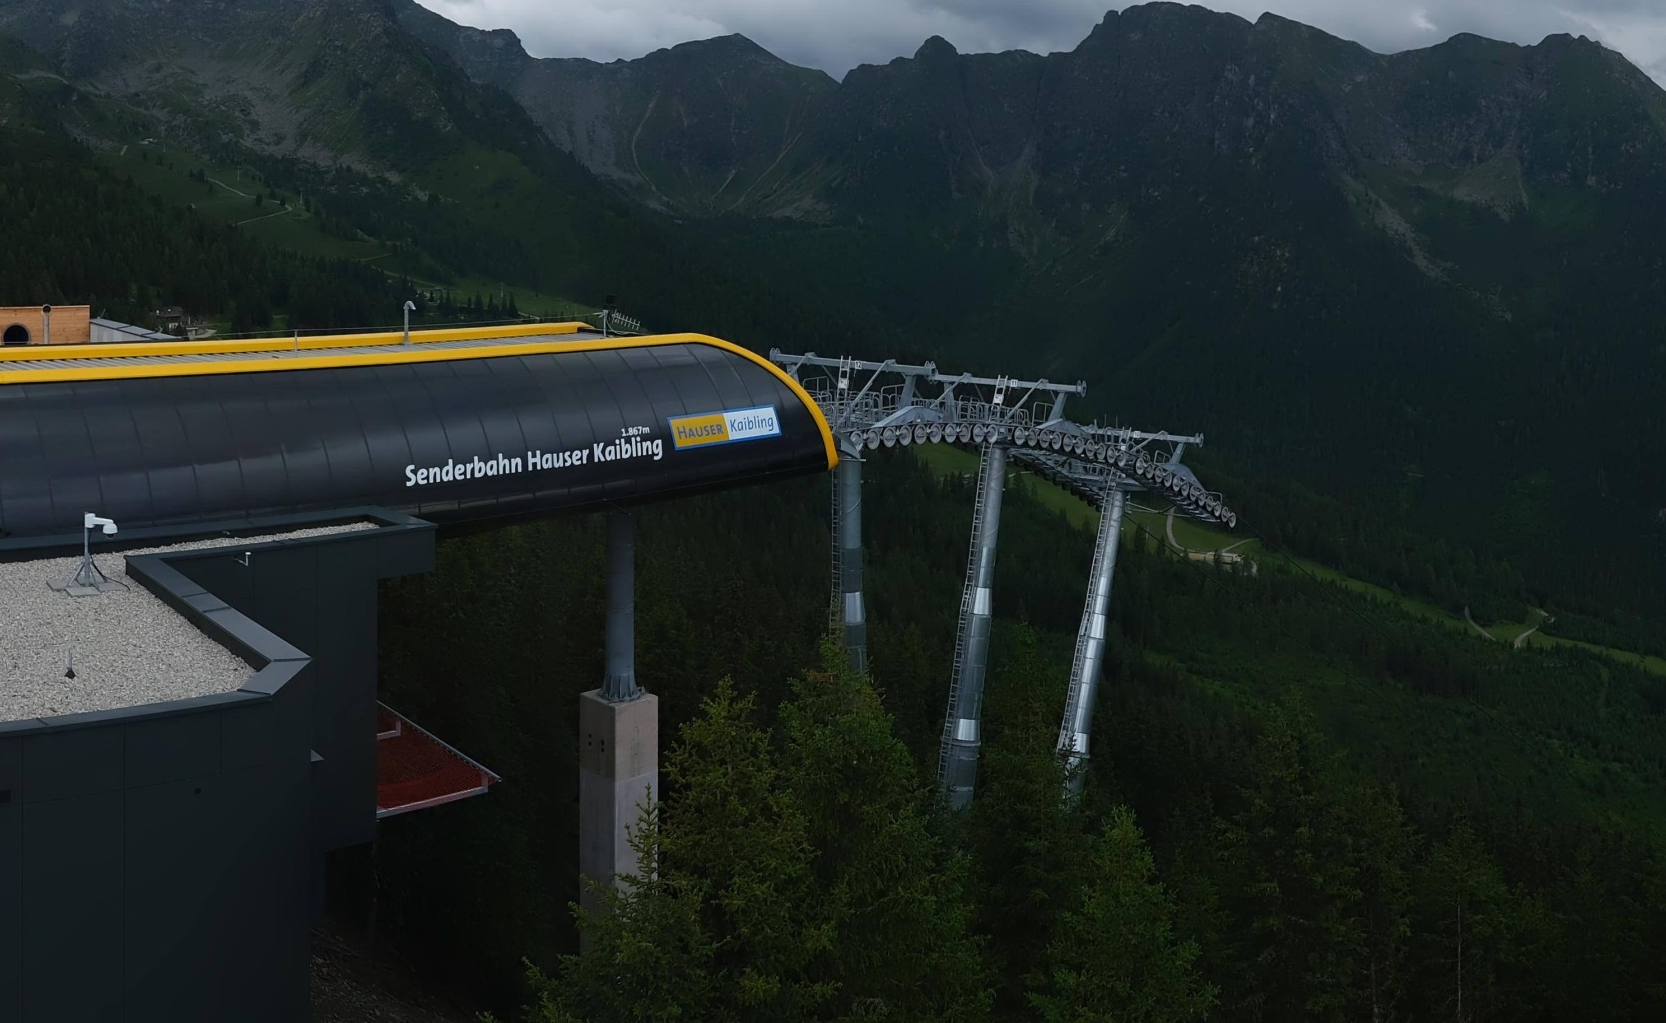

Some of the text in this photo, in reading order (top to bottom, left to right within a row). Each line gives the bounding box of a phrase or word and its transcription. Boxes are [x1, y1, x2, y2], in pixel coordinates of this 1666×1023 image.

[621, 426, 650, 437] 1.867m
[677, 415, 774, 440] HAUSER Kaibling
[405, 437, 663, 487] Senderbahn Hauser Kaibling
